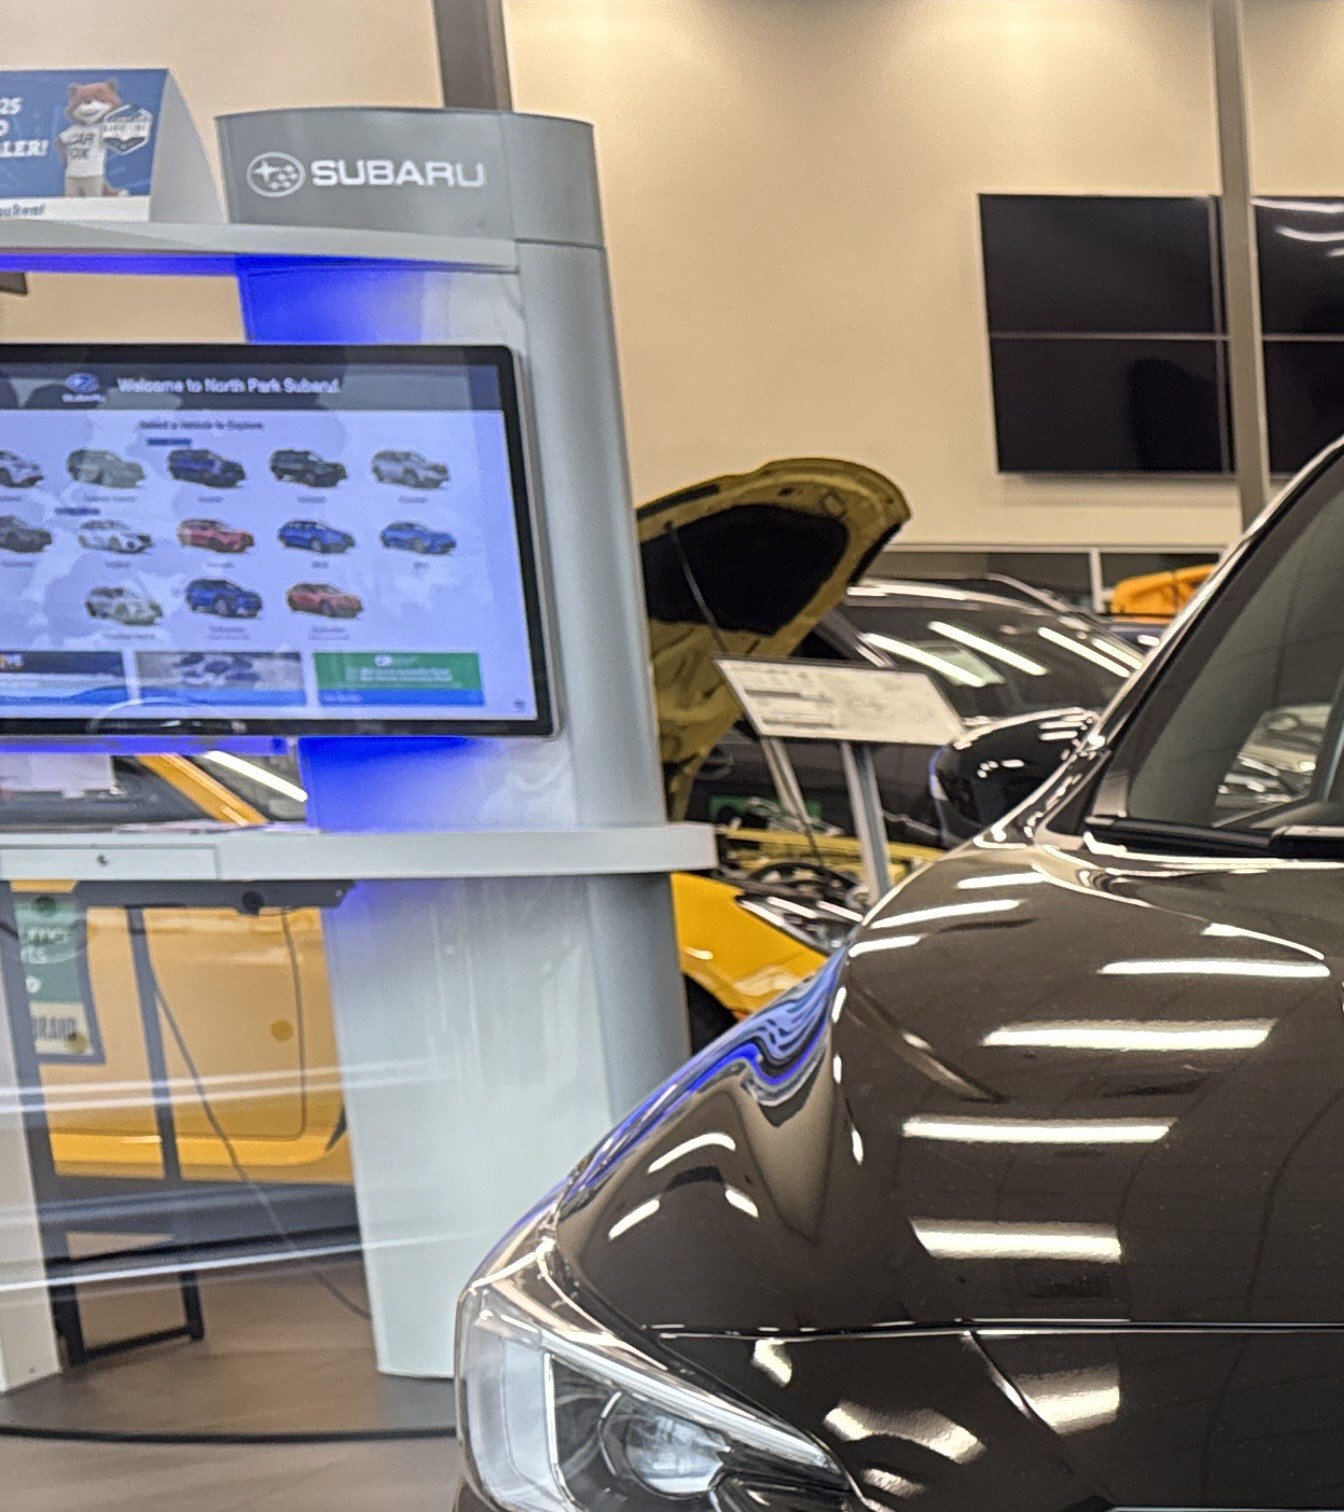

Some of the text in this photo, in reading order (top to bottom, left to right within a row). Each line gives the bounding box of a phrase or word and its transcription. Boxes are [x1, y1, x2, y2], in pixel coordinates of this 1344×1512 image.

[0, 139, 49, 158] LER!
[310, 158, 487, 188] SUBARU
[117, 377, 184, 393] Welcome
[186, 378, 202, 393] to
[204, 378, 246, 393] North
[248, 378, 281, 393] Park
